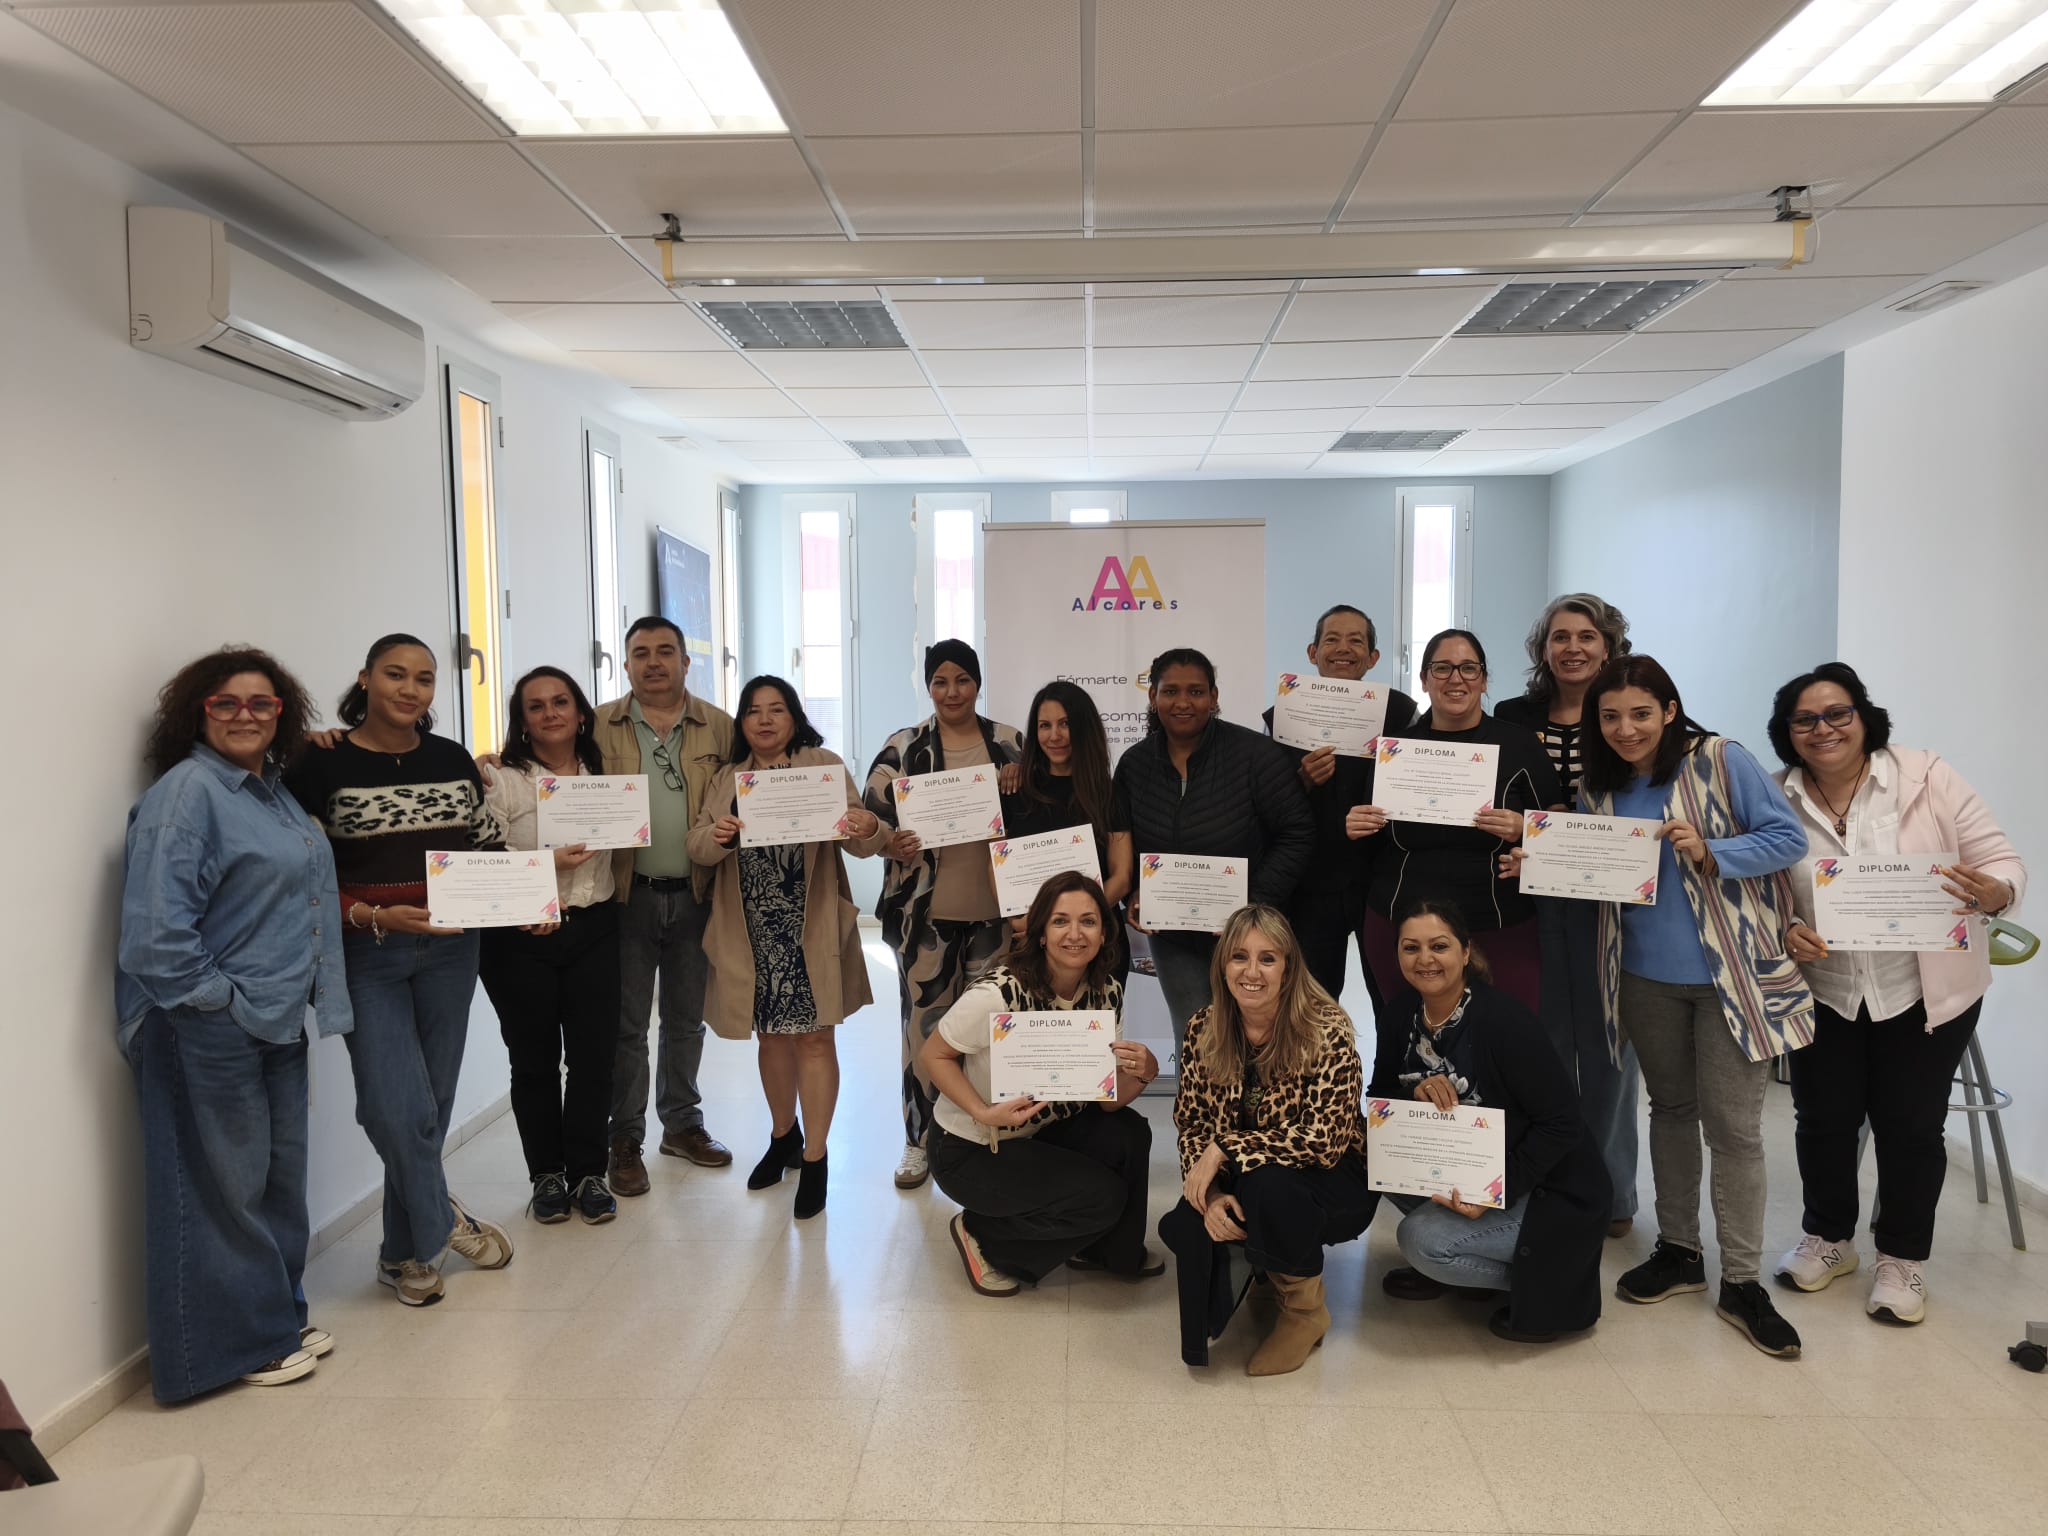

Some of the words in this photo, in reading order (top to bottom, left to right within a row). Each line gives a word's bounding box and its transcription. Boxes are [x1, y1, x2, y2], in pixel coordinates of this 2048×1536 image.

[1072, 595, 1178, 611] Alcores
[1056, 674, 1128, 685] Fórmarte
[1312, 684, 1350, 694] DIPLOMA
[1414, 748, 1456, 757] DIPLOMA
[770, 775, 808, 783] DIPLOMA
[924, 776, 960, 787] DIPLOMA
[1566, 822, 1613, 832] DIPLOMA
[1023, 838, 1059, 850] DIPLOMA
[1174, 862, 1211, 870] DIPLOMA
[1859, 864, 1910, 872] DIPLOMA
[1029, 1019, 1072, 1028] DIPLOMA
[1408, 1110, 1456, 1121] DIPLOMA
